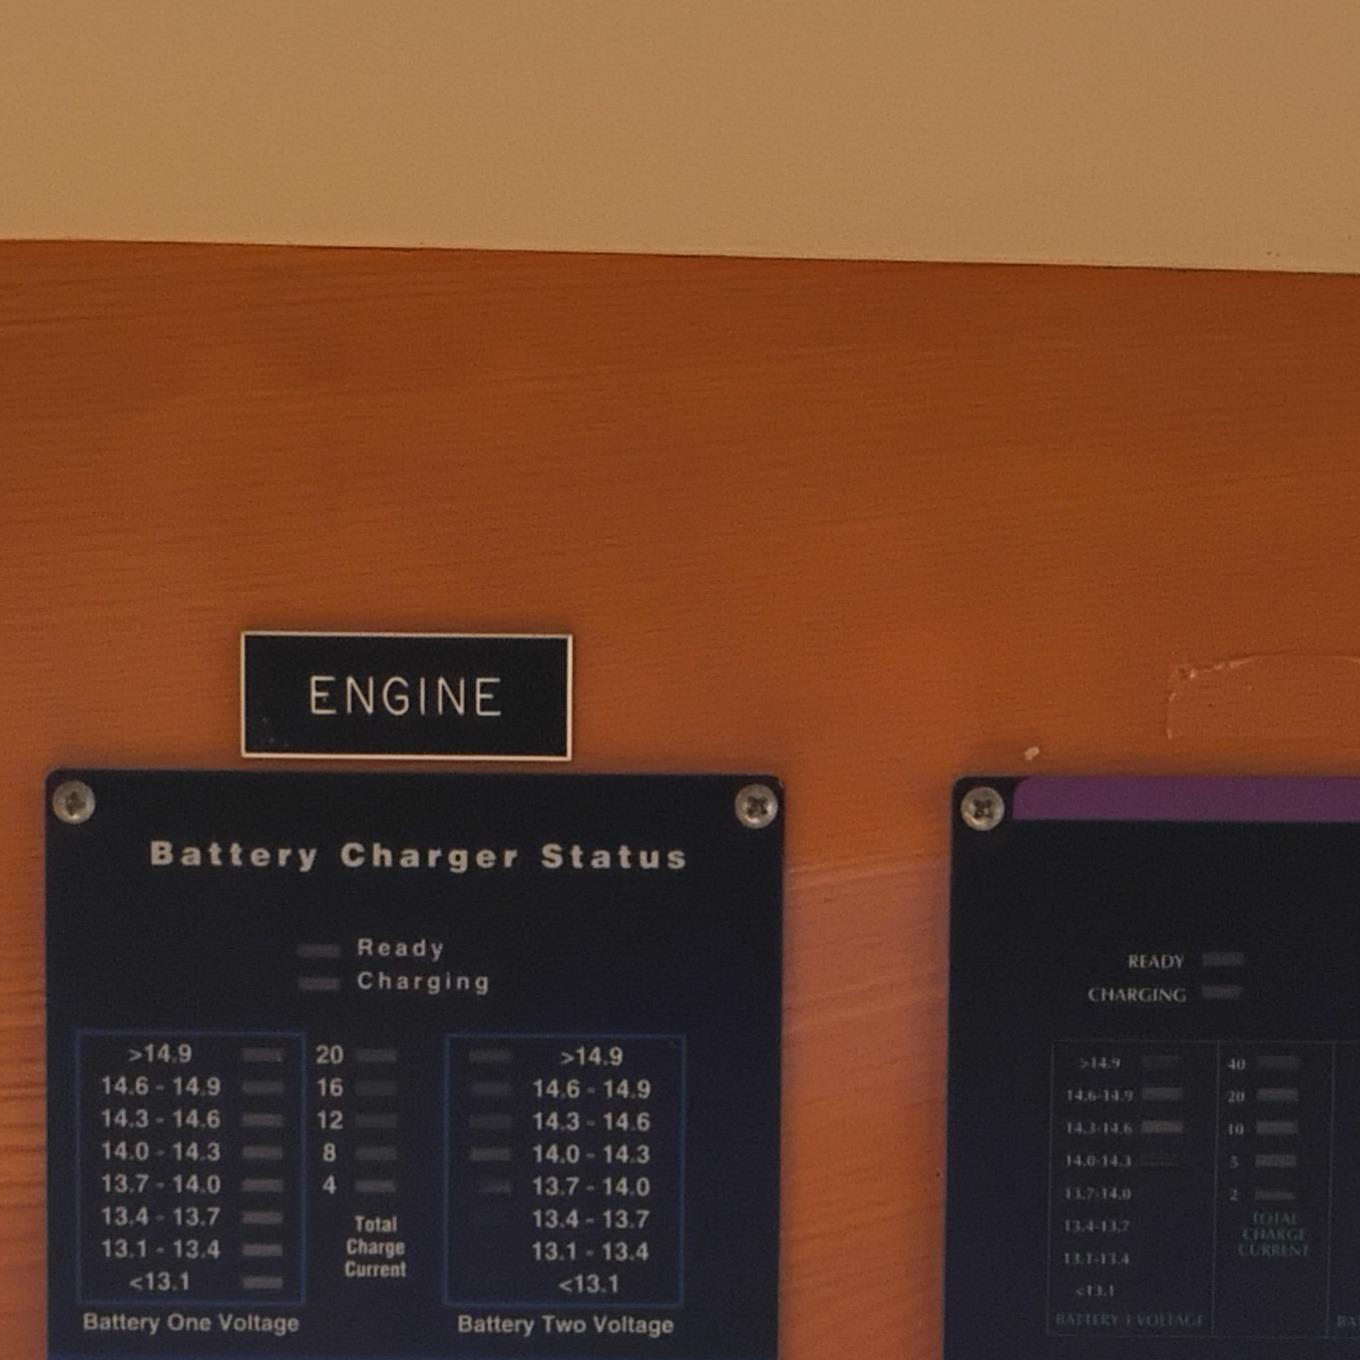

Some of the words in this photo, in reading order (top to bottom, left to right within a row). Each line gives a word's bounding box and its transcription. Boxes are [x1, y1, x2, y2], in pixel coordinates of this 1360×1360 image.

[310, 675, 501, 716] ENGINE
[151, 841, 316, 872] Battery
[341, 842, 517, 873] Charger
[542, 843, 685, 869] Status
[358, 938, 443, 961] Ready
[1128, 955, 1183, 968] READY
[357, 971, 488, 995] Charging
[1088, 988, 1186, 1002] CHARGING
[130, 1044, 192, 1063] >14.9
[317, 1045, 343, 1064] 20
[562, 1047, 623, 1066] >14.9
[1228, 1059, 1246, 1070] 40
[103, 1076, 148, 1095] 14.6
[174, 1077, 220, 1096] 14.9
[318, 1078, 343, 1097] 16
[534, 1079, 580, 1098] 14.6
[605, 1079, 651, 1099] 14.9
[1228, 1091, 1245, 1103] 20
[102, 1109, 148, 1128] 14.3
[174, 1109, 220, 1128] 14.6
[318, 1110, 343, 1129] 12
[534, 1112, 579, 1131] 14.3
[604, 1112, 650, 1131] 14.6
[1228, 1124, 1244, 1135] 10
[103, 1141, 149, 1161] 14.0
[174, 1142, 220, 1161] 14.3
[323, 1143, 336, 1162] 8
[534, 1144, 580, 1164] 14.0
[604, 1145, 650, 1164] 14.3
[1231, 1155, 1239, 1168] 5
[102, 1174, 149, 1193] 13.7
[174, 1174, 220, 1194] 14.0
[323, 1175, 336, 1194] 4
[533, 1176, 579, 1196] 13.7
[604, 1177, 650, 1196] 14.0
[1230, 1189, 1238, 1201] 2
[102, 1206, 148, 1225] 13.4
[174, 1207, 220, 1226] 13.7
[355, 1215, 397, 1232] Total
[533, 1209, 579, 1228] 13.4
[604, 1209, 649, 1228] 13.7
[102, 1239, 146, 1258] 13.1
[174, 1239, 220, 1258] 13.4
[346, 1238, 405, 1259] Charge
[533, 1241, 575, 1261] 13.1
[603, 1242, 649, 1261] 13.4
[345, 1260, 406, 1277] Current
[130, 1272, 188, 1291] <13.1
[559, 1274, 618, 1293] <13.1
[83, 1313, 160, 1335] Battery
[167, 1313, 212, 1331] One
[218, 1313, 299, 1336] Voltage
[458, 1315, 534, 1337] Battery
[542, 1315, 586, 1333] Two
[593, 1316, 674, 1338] Voltage
